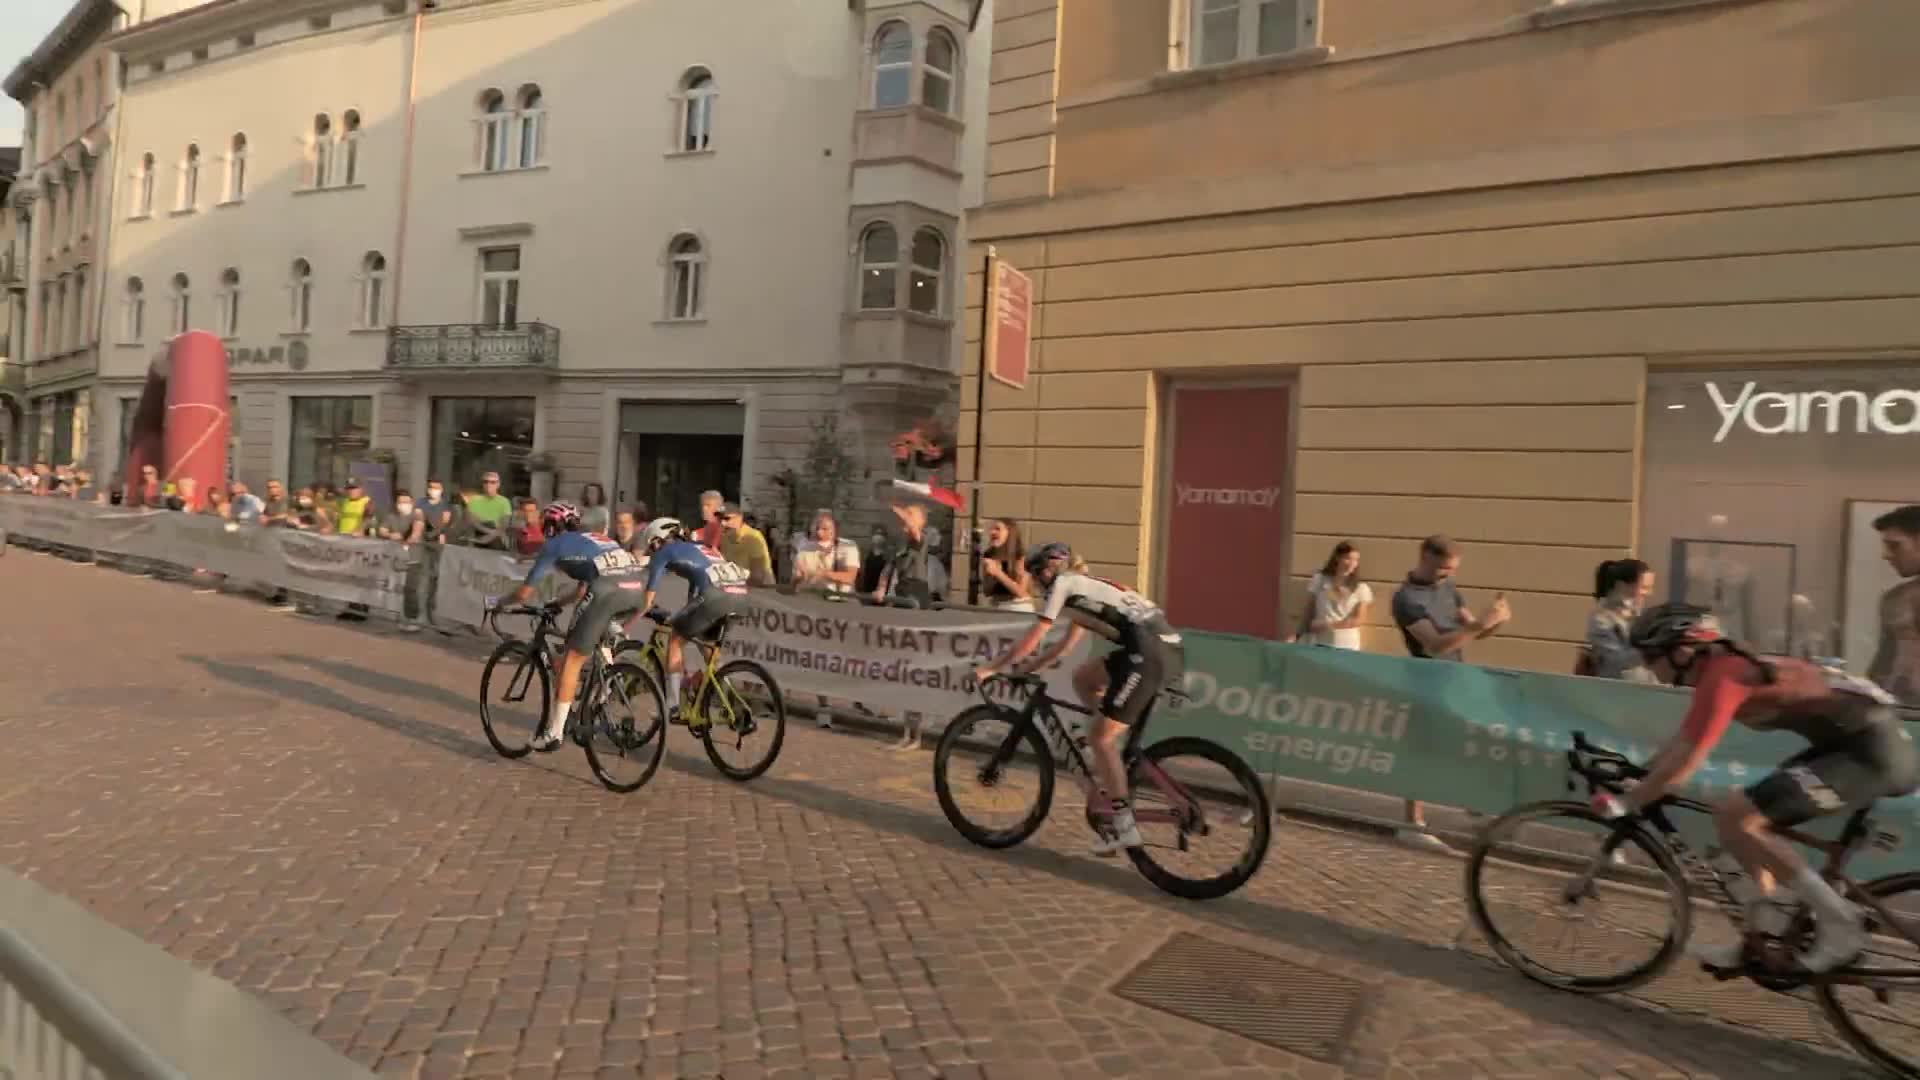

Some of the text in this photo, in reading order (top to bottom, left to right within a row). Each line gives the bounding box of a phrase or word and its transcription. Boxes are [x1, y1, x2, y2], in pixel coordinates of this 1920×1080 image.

[859, 622, 938, 655] THAT
[1182, 671, 1411, 742] Dolomiti
[1246, 731, 1396, 775] energia
